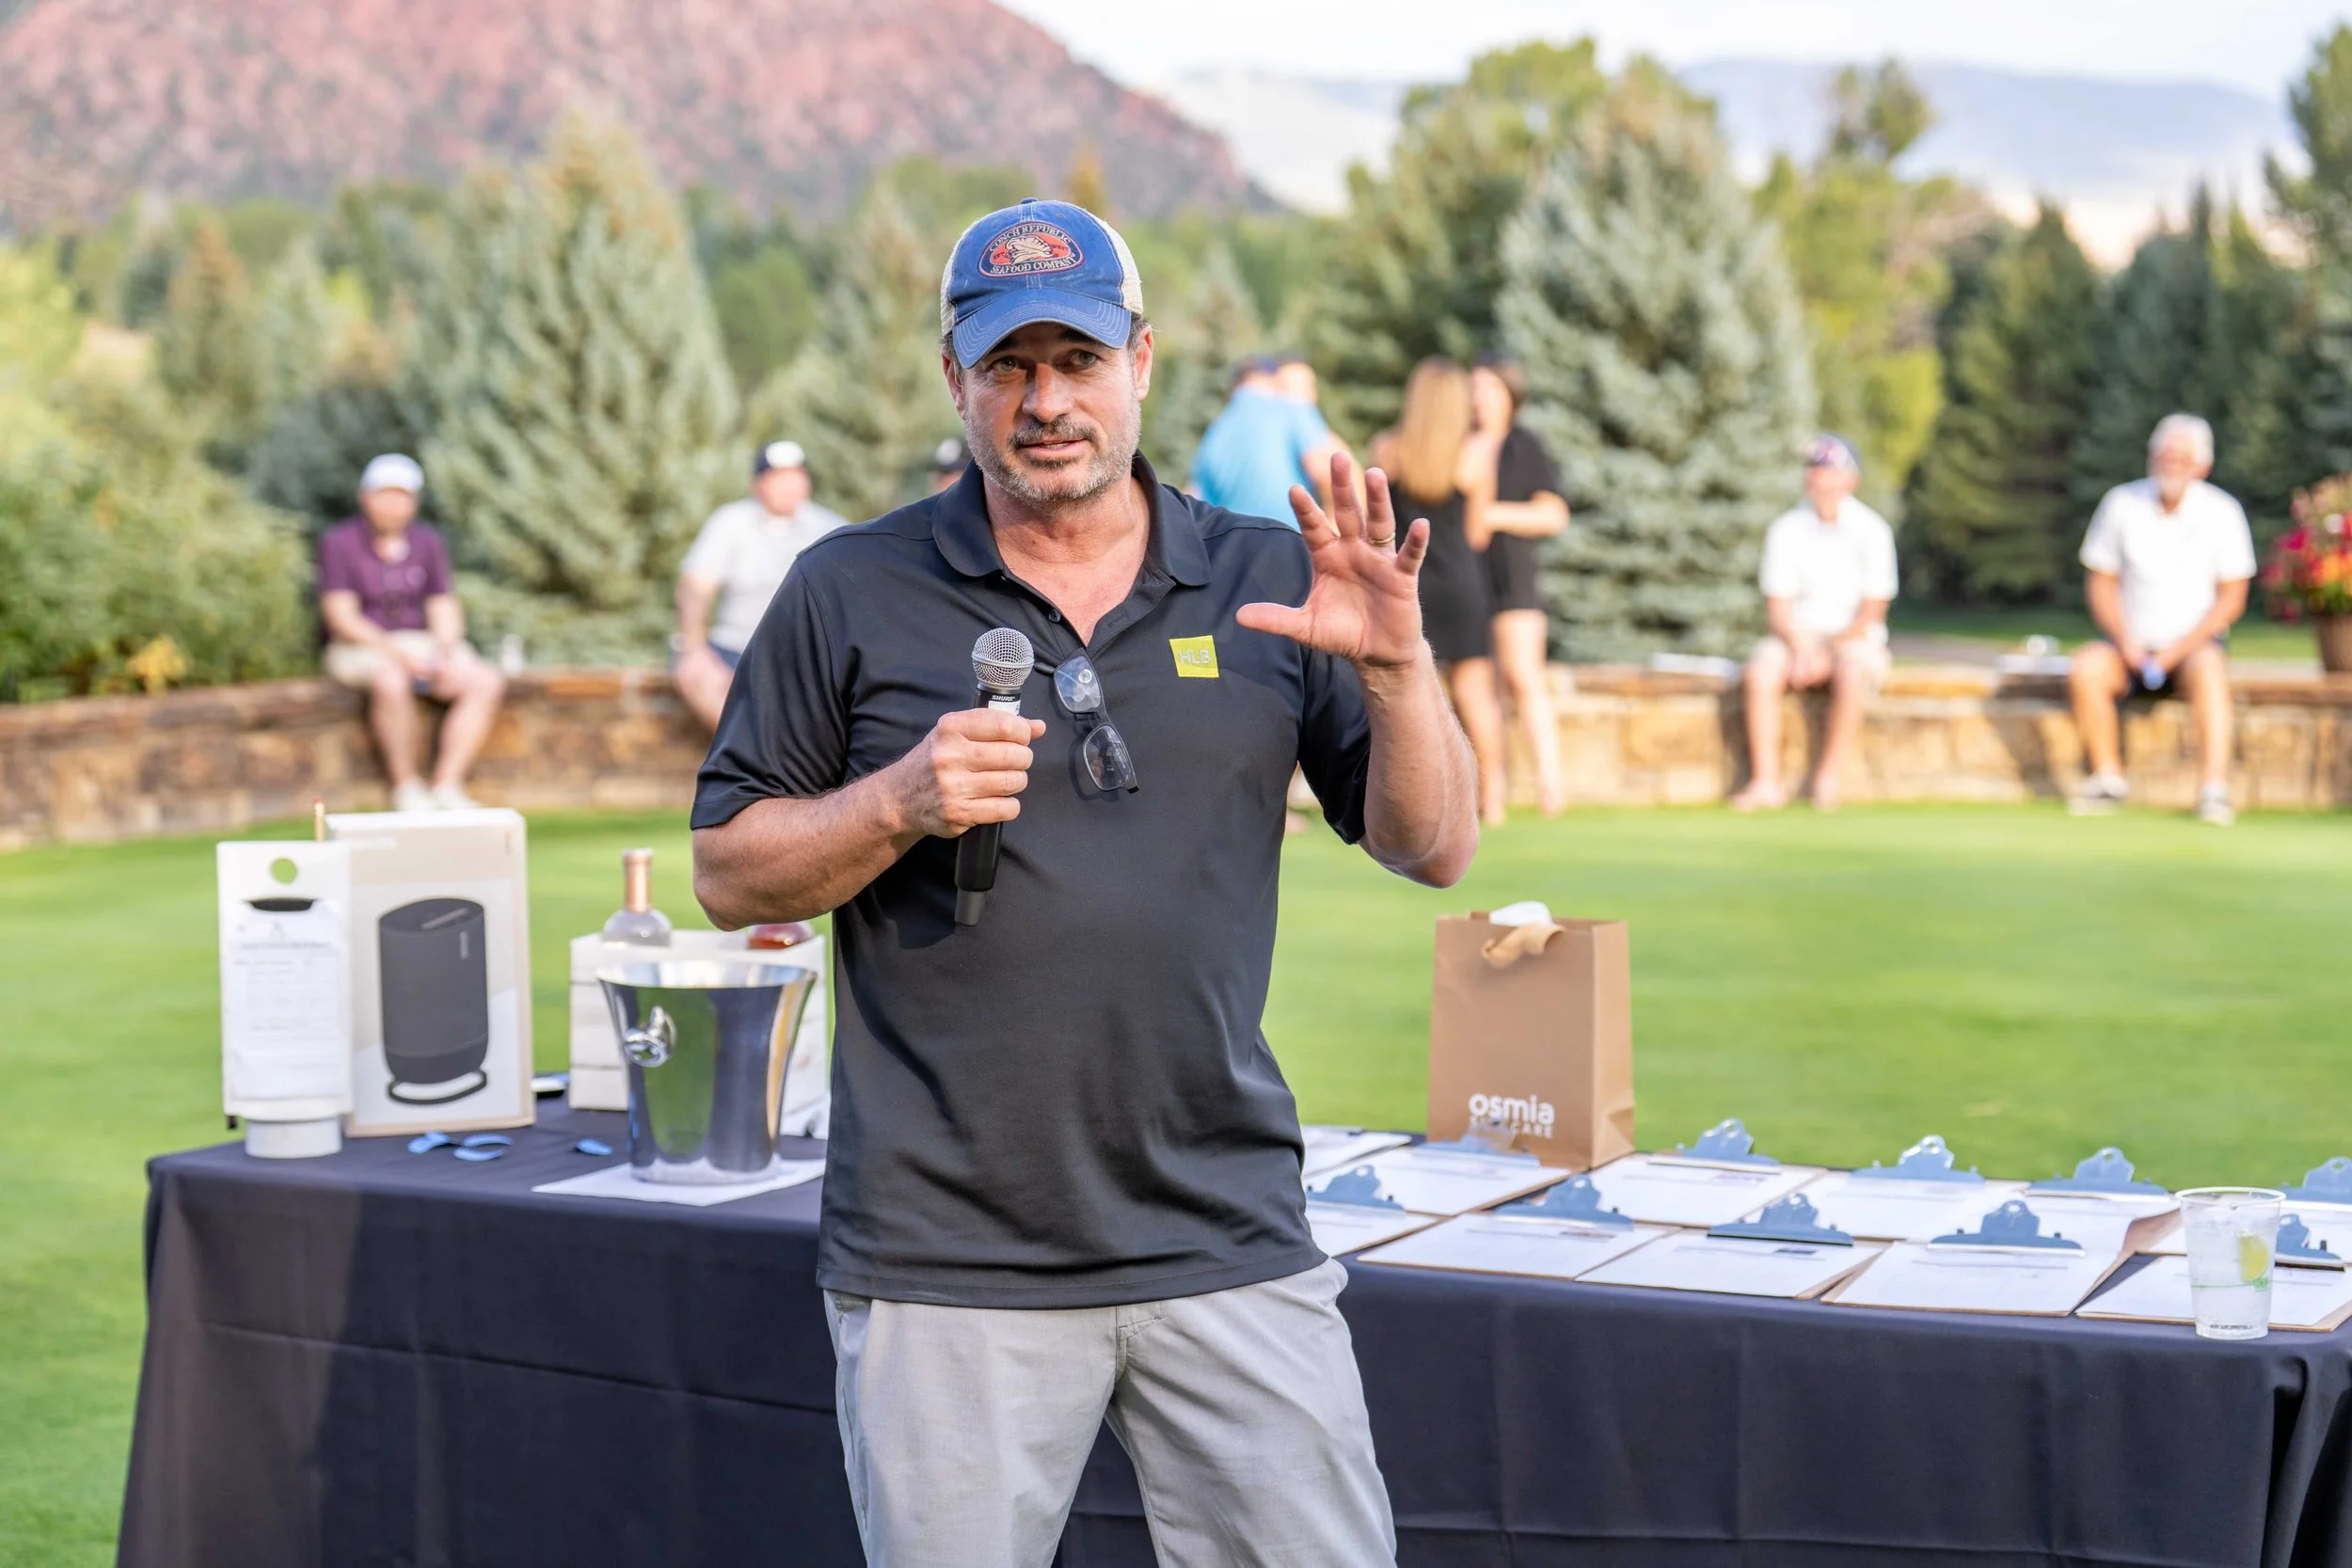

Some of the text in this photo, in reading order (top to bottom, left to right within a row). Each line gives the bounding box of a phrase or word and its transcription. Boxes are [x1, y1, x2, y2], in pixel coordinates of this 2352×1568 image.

[989, 225, 1072, 252] CONCH REPUBLIC
[990, 253, 1077, 275] SEAFOOD COMPANY
[1179, 649, 1211, 664] HLB
[1469, 1094, 1554, 1124] osmia
